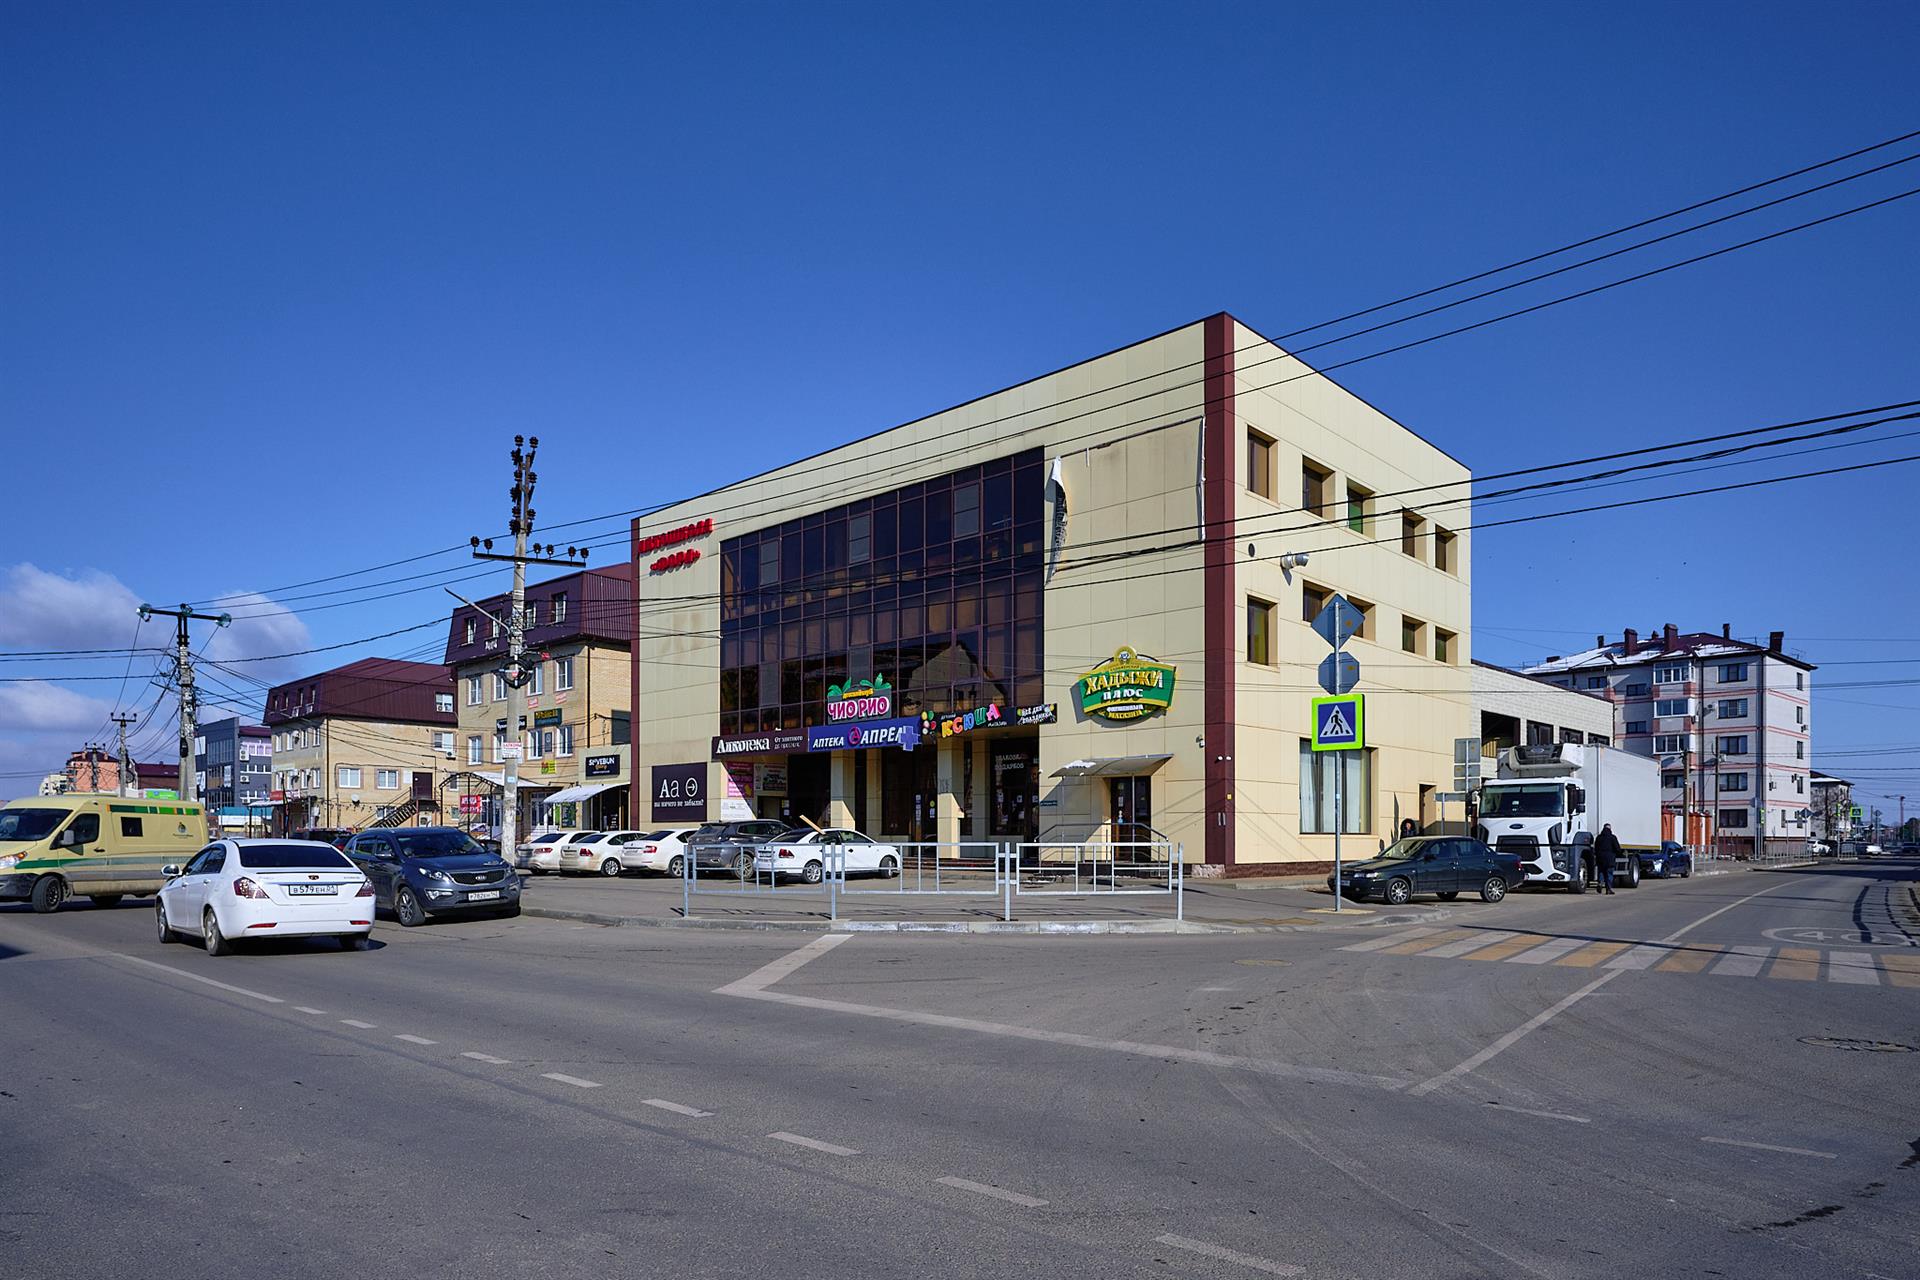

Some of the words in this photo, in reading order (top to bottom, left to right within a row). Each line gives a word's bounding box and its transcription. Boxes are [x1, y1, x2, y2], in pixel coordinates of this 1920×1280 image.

[1084, 670, 1163, 695] ХАДЫЖИ
[1103, 688, 1144, 701] ПЛЮС
[828, 700, 856, 720] ЧИО
[859, 697, 890, 718] РИО
[941, 703, 1000, 738] КСЮША
[813, 736, 844, 749] АПТЕКА
